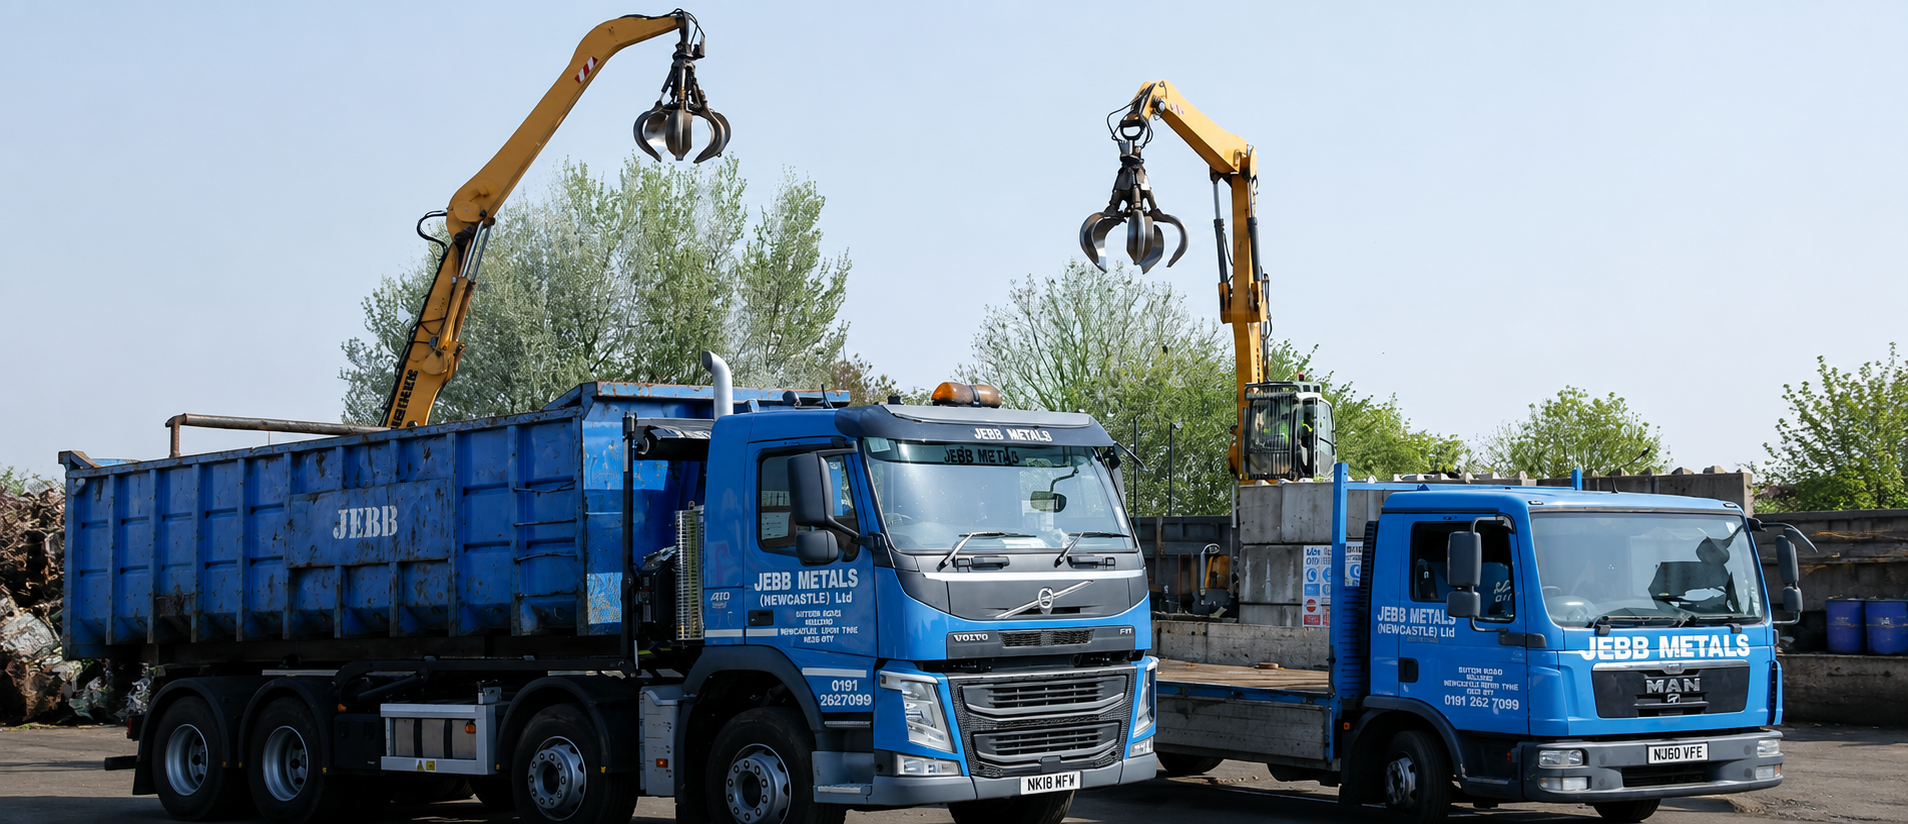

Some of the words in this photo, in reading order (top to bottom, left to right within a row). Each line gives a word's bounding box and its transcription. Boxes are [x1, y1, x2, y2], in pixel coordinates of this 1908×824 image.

[974, 427, 1004, 440] JEBB
[1006, 428, 1053, 442] METALS
[332, 504, 398, 540] JEBB
[754, 572, 792, 592] JEBB
[798, 568, 859, 590] METALS
[759, 591, 830, 608] (NEWCASTLE)
[835, 590, 853, 604] Ltd
[1377, 605, 1406, 623] JEBB
[953, 633, 989, 642] VOLVO
[1377, 622, 1438, 639] (NEWCASTLE)
[1580, 635, 1650, 661] JEBB
[1659, 633, 1751, 659] METALS
[831, 679, 858, 692] 0191
[1645, 677, 1701, 694] MAN
[820, 693, 872, 706] 2627099
[1444, 694, 1466, 707] 0191
[1469, 695, 1489, 708] 262
[1491, 697, 1520, 711] 7099
[1653, 747, 1681, 761] NJ60
[1683, 745, 1703, 759] VFE
[1027, 776, 1053, 791] NK18
